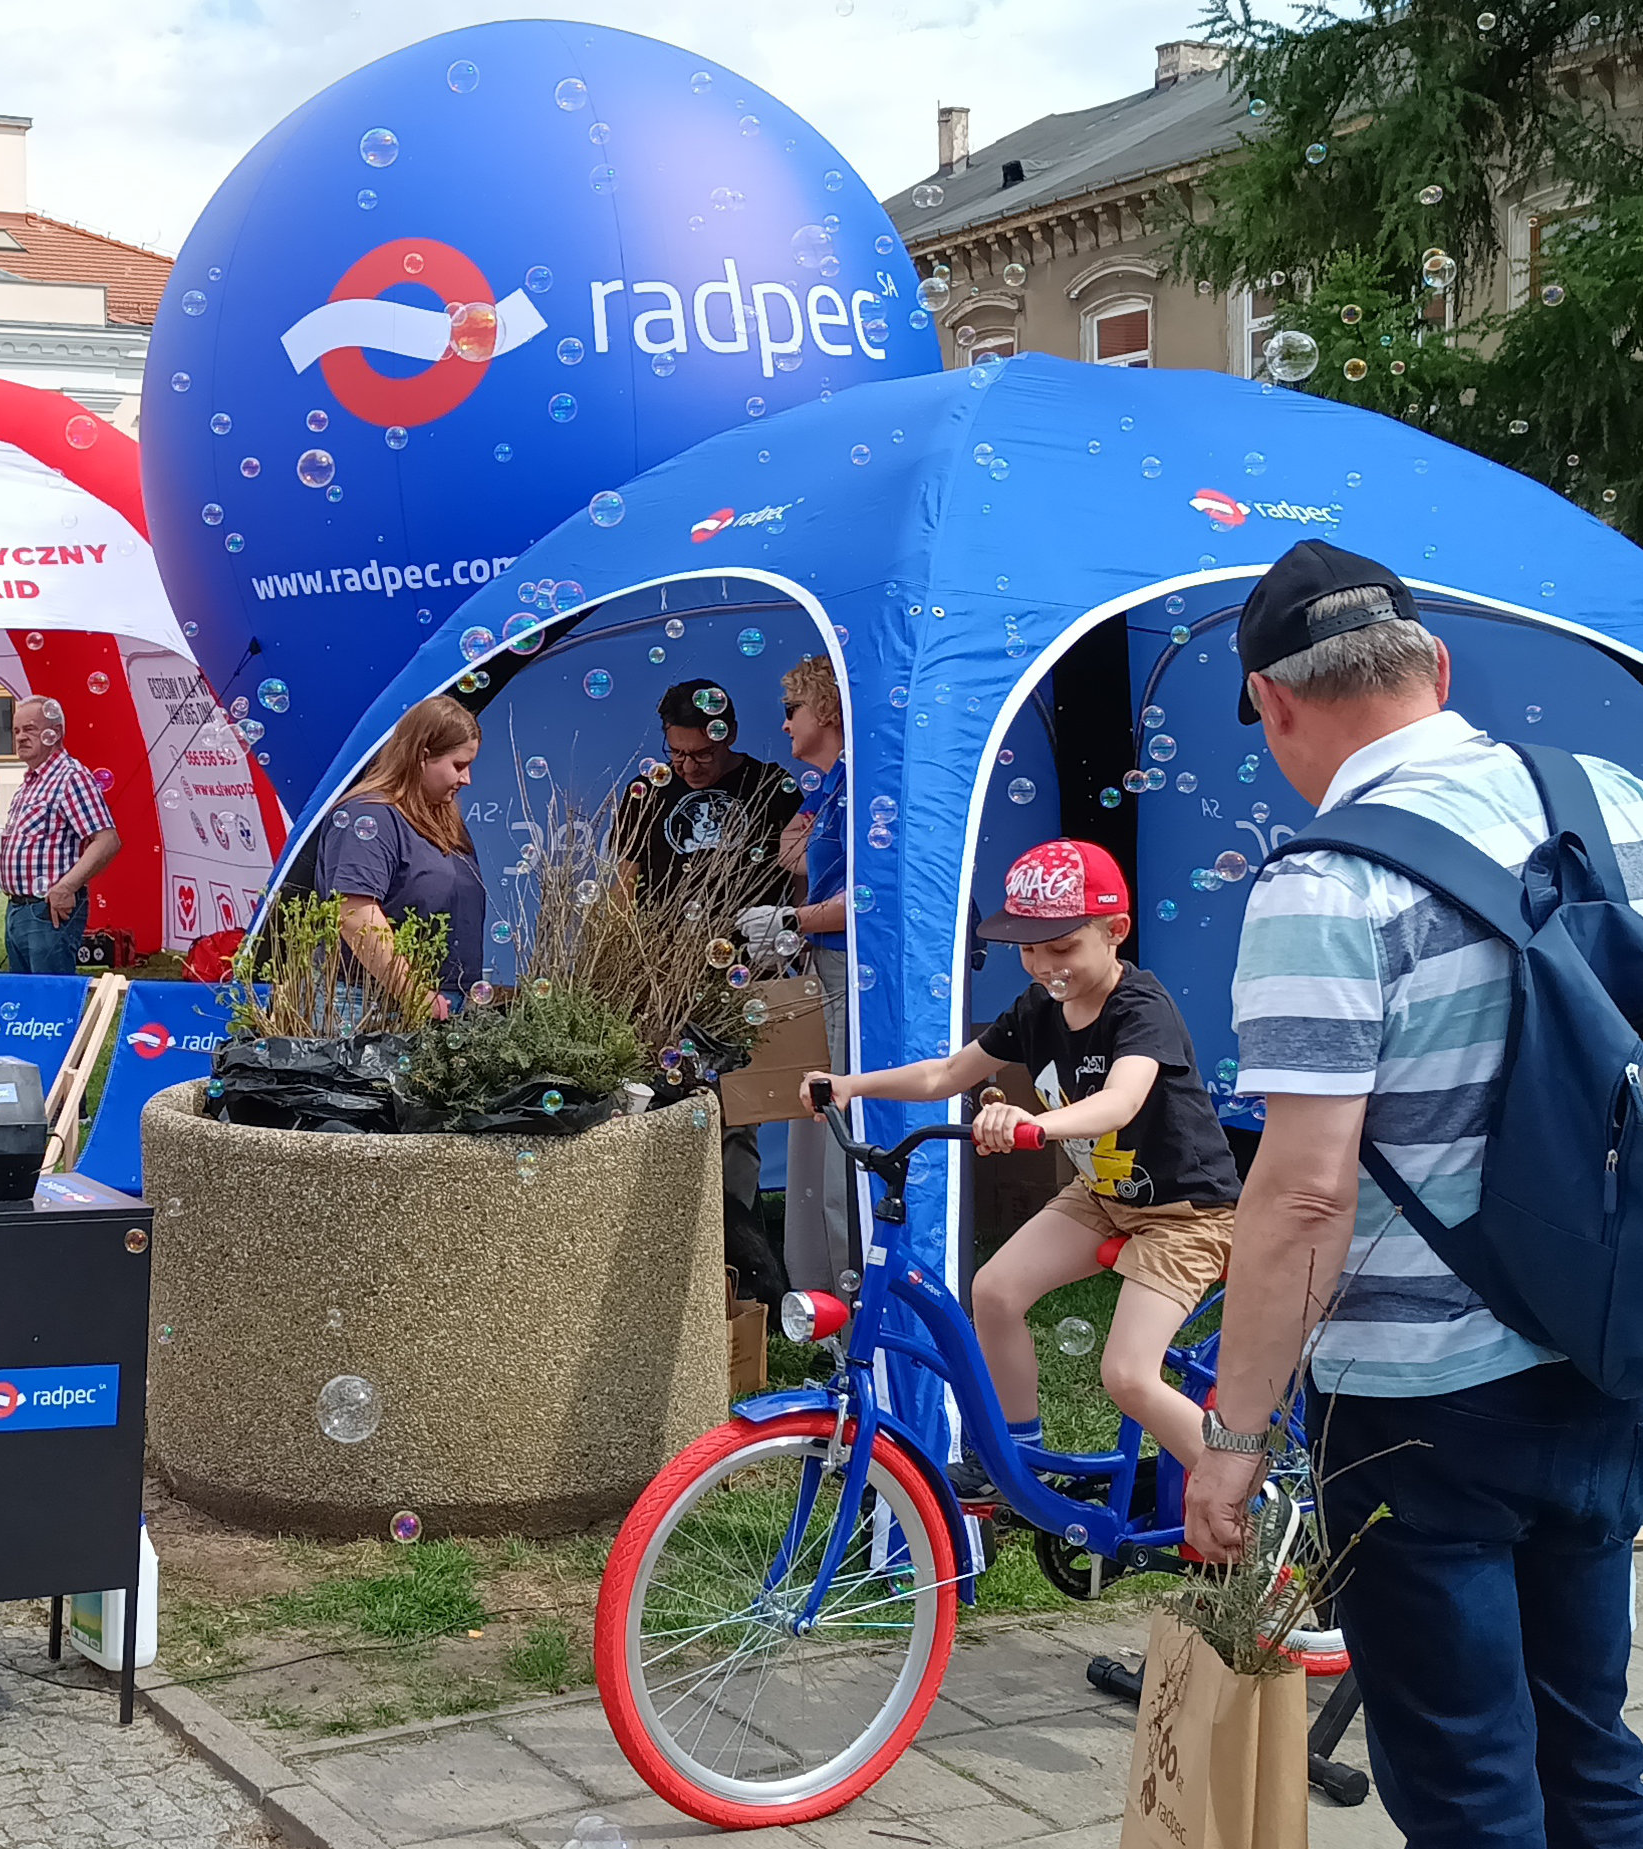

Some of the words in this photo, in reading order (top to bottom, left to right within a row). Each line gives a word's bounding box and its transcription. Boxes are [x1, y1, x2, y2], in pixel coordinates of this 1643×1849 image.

[589, 258, 887, 377] radpec
[874, 271, 899, 297] SA
[1254, 501, 1340, 524] radpec
[5, 1017, 64, 1040] radpec
[33, 1385, 97, 1409] radpec
[1158, 1724, 1178, 1782] 60
[1156, 1800, 1188, 1846] radpec
